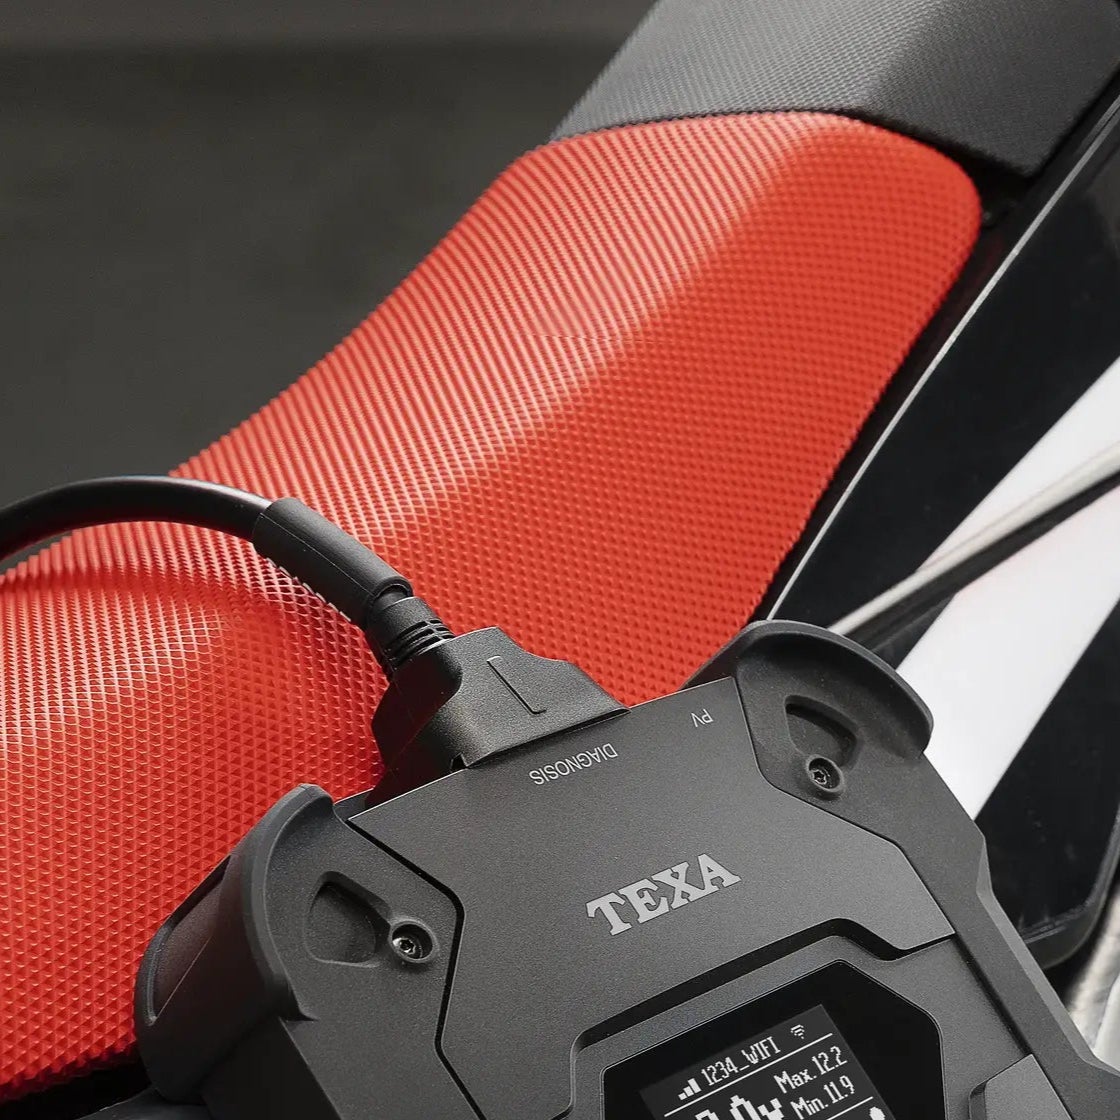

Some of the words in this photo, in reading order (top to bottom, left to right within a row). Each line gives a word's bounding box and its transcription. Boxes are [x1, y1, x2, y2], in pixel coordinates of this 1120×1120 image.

[690, 708, 714, 728] PV
[528, 743, 618, 785] DIAGNOSIS
[586, 853, 742, 936] TEXA
[701, 1036, 781, 1086] 1234_WIFI
[773, 1070, 817, 1094] Max.
[811, 1046, 847, 1075] 12.2
[790, 1096, 829, 1120] Min.
[822, 1075, 855, 1103] 11.9
